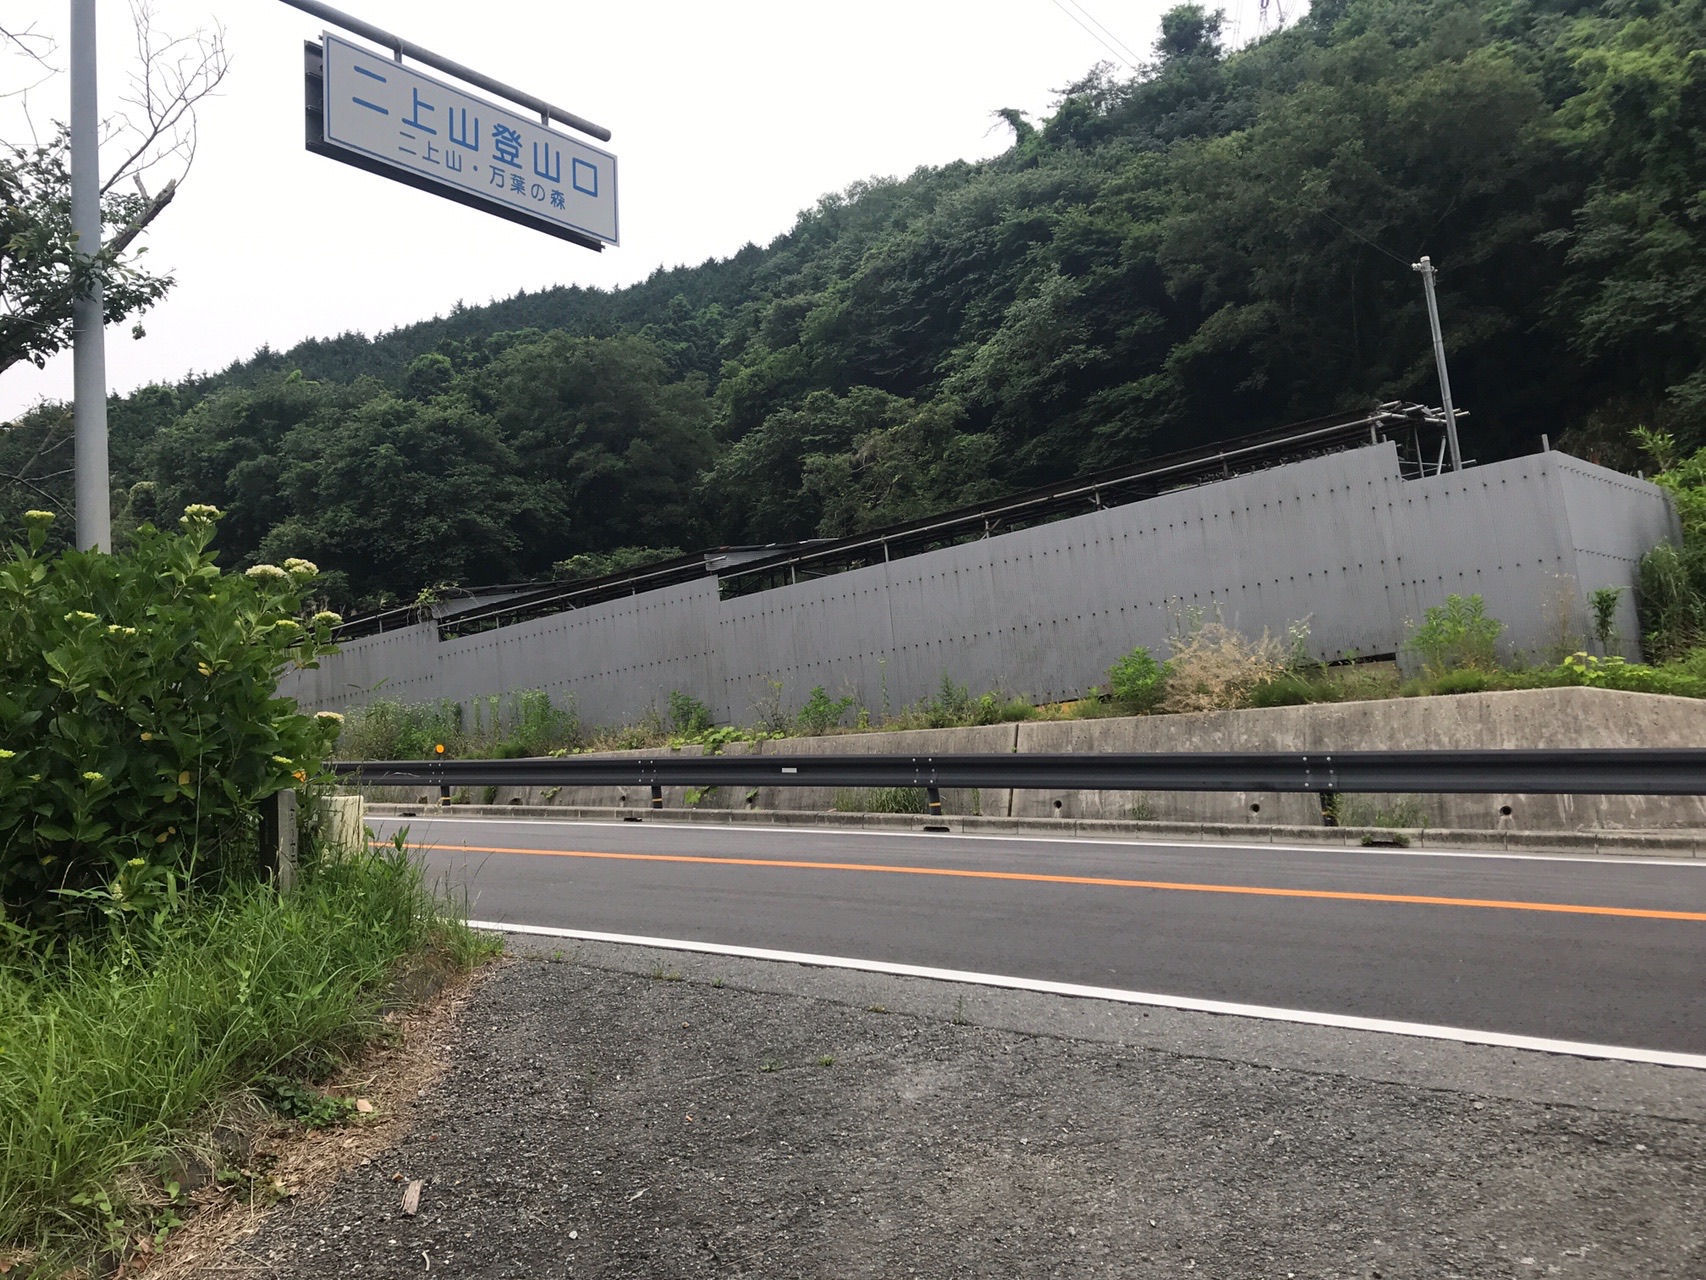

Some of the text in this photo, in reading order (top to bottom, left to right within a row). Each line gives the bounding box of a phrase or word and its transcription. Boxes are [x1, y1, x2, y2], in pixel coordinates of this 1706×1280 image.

[352, 65, 598, 198] 二上山登山口
[398, 131, 566, 210] 二上山・万葉の森
